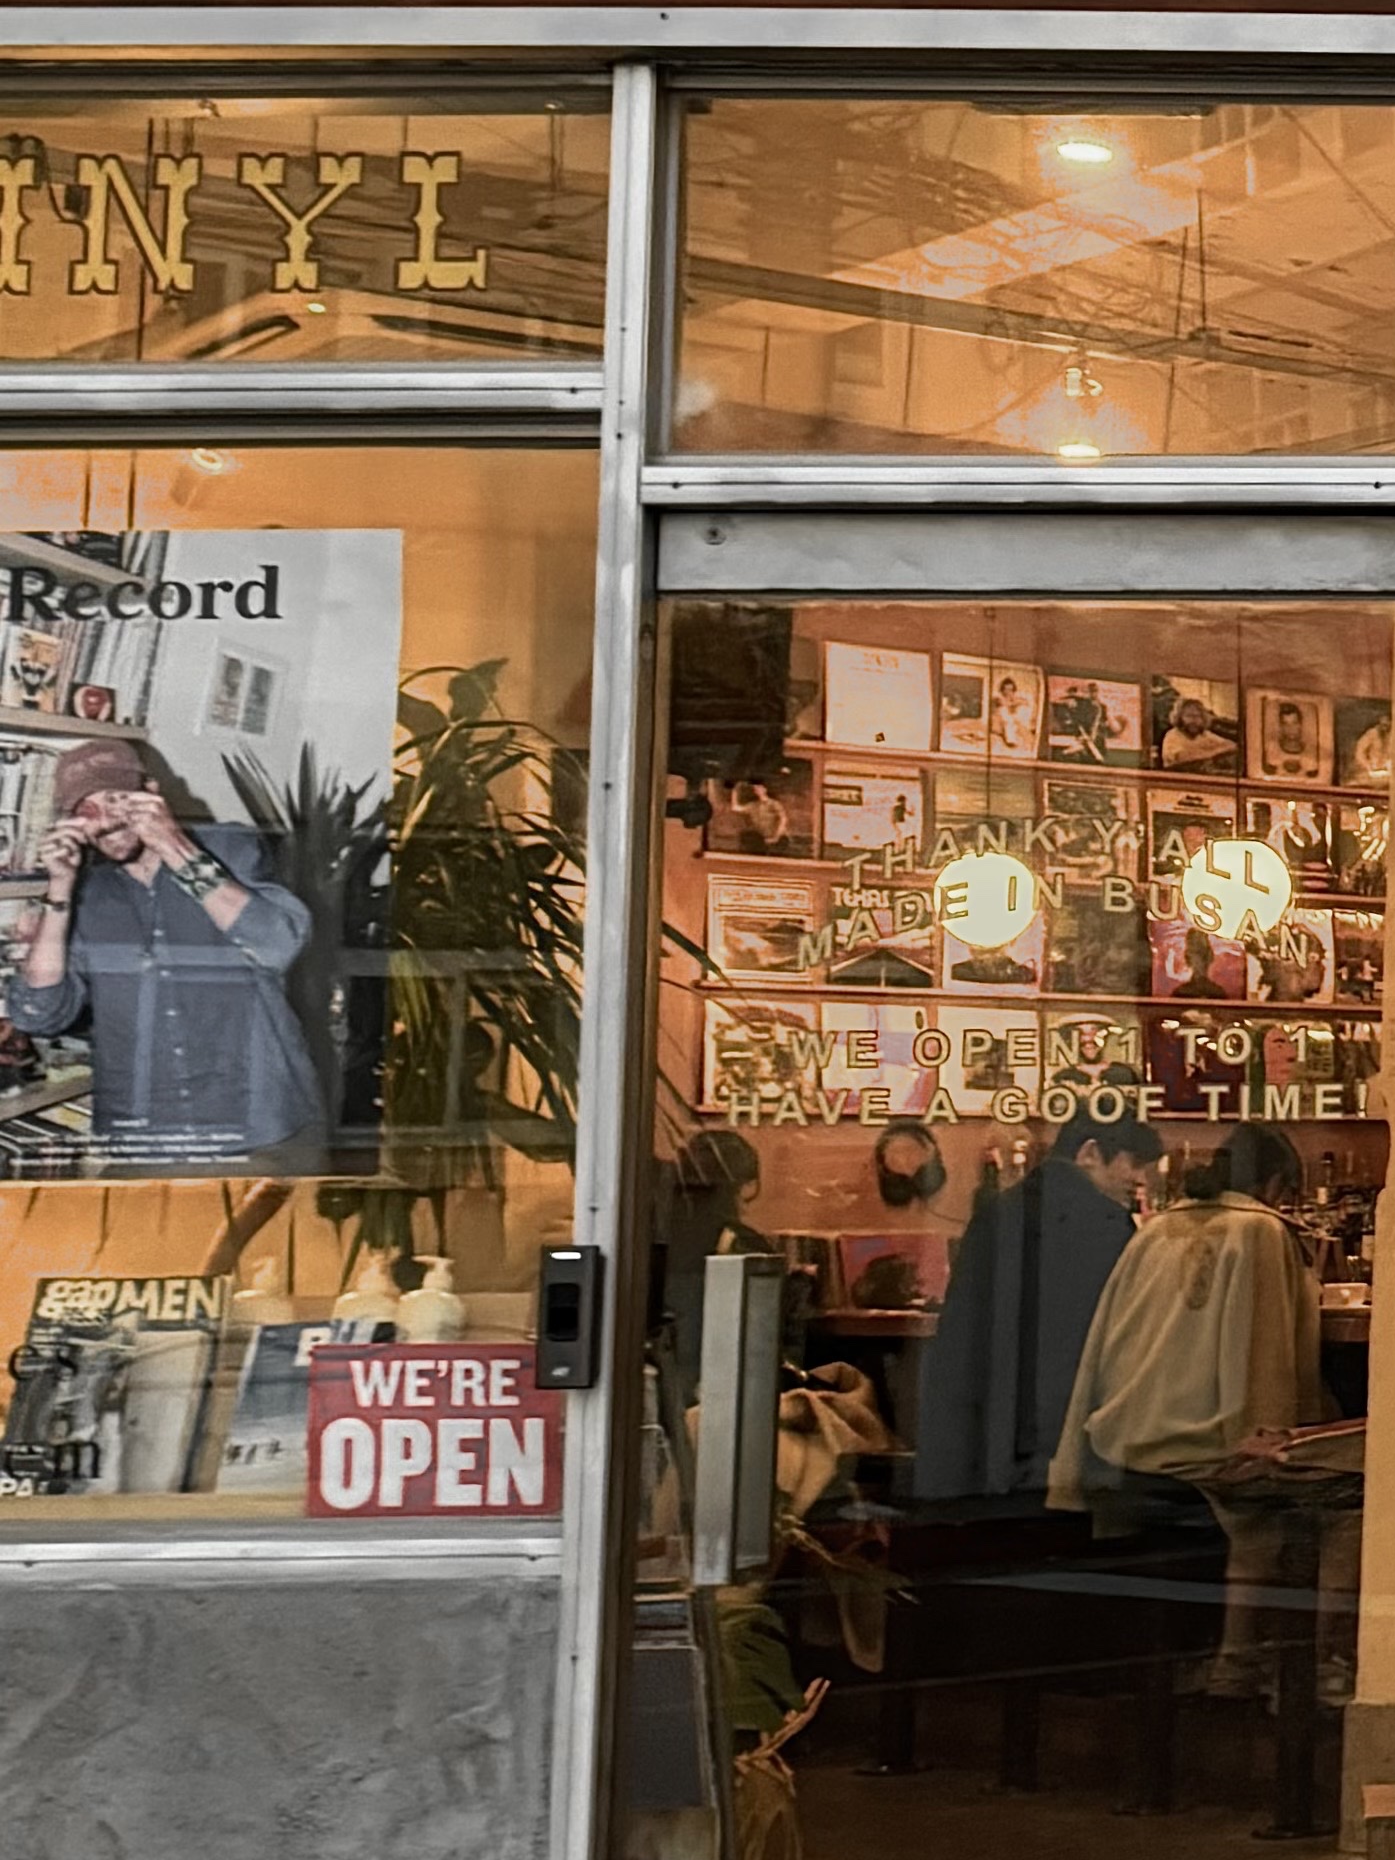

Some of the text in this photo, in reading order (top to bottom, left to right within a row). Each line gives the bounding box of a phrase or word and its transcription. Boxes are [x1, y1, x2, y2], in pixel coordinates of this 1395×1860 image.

[6, 565, 284, 621] Record
[843, 818, 1060, 891] THANK
[798, 874, 1308, 971] MADE IN BUSAN
[791, 1025, 1308, 1069] WE OPEN 1 TO 1
[728, 1083, 1368, 1126] HAVE A GOOF TIME!
[350, 1360, 521, 1408] WE'RE
[319, 1418, 545, 1510] OPEN
